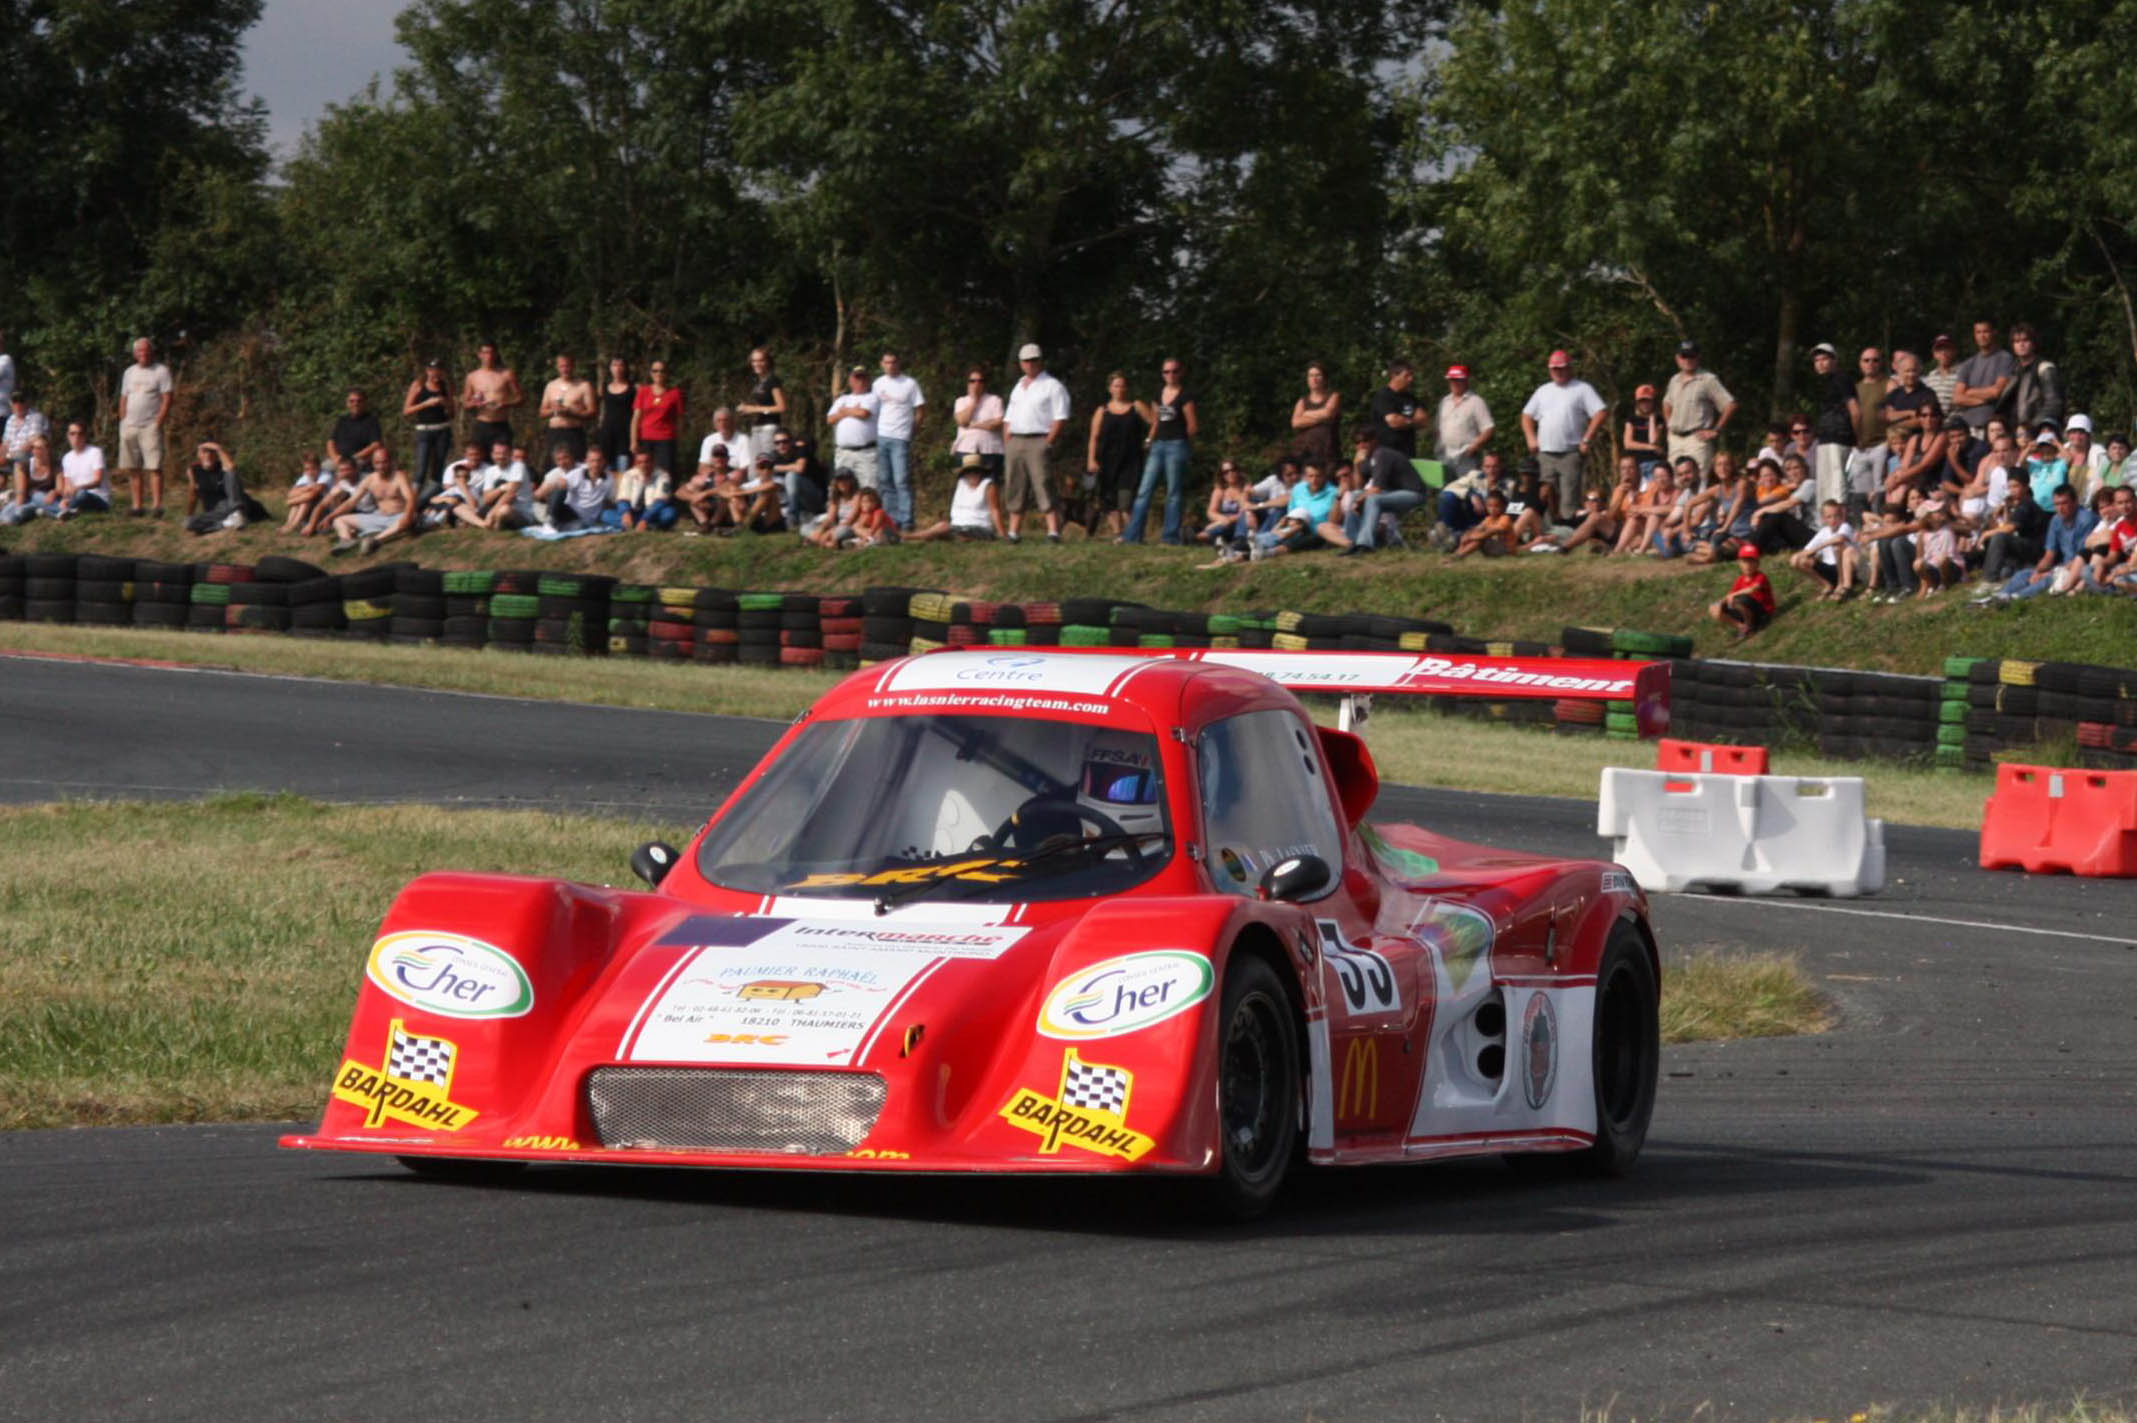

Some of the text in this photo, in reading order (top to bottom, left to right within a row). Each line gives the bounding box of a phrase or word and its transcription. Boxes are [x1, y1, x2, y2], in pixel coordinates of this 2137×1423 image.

[956, 668, 1043, 681] Centre
[1415, 655, 1636, 693] Bâtiment
[867, 694, 1109, 714] www.lasnierracingteam.com
[393, 945, 496, 1003] Cher
[720, 965, 798, 978] PAUMIER
[1064, 969, 1179, 1025] Cher
[338, 1066, 466, 1128] BARDAHL
[1011, 1095, 1141, 1155] BARDAHL
